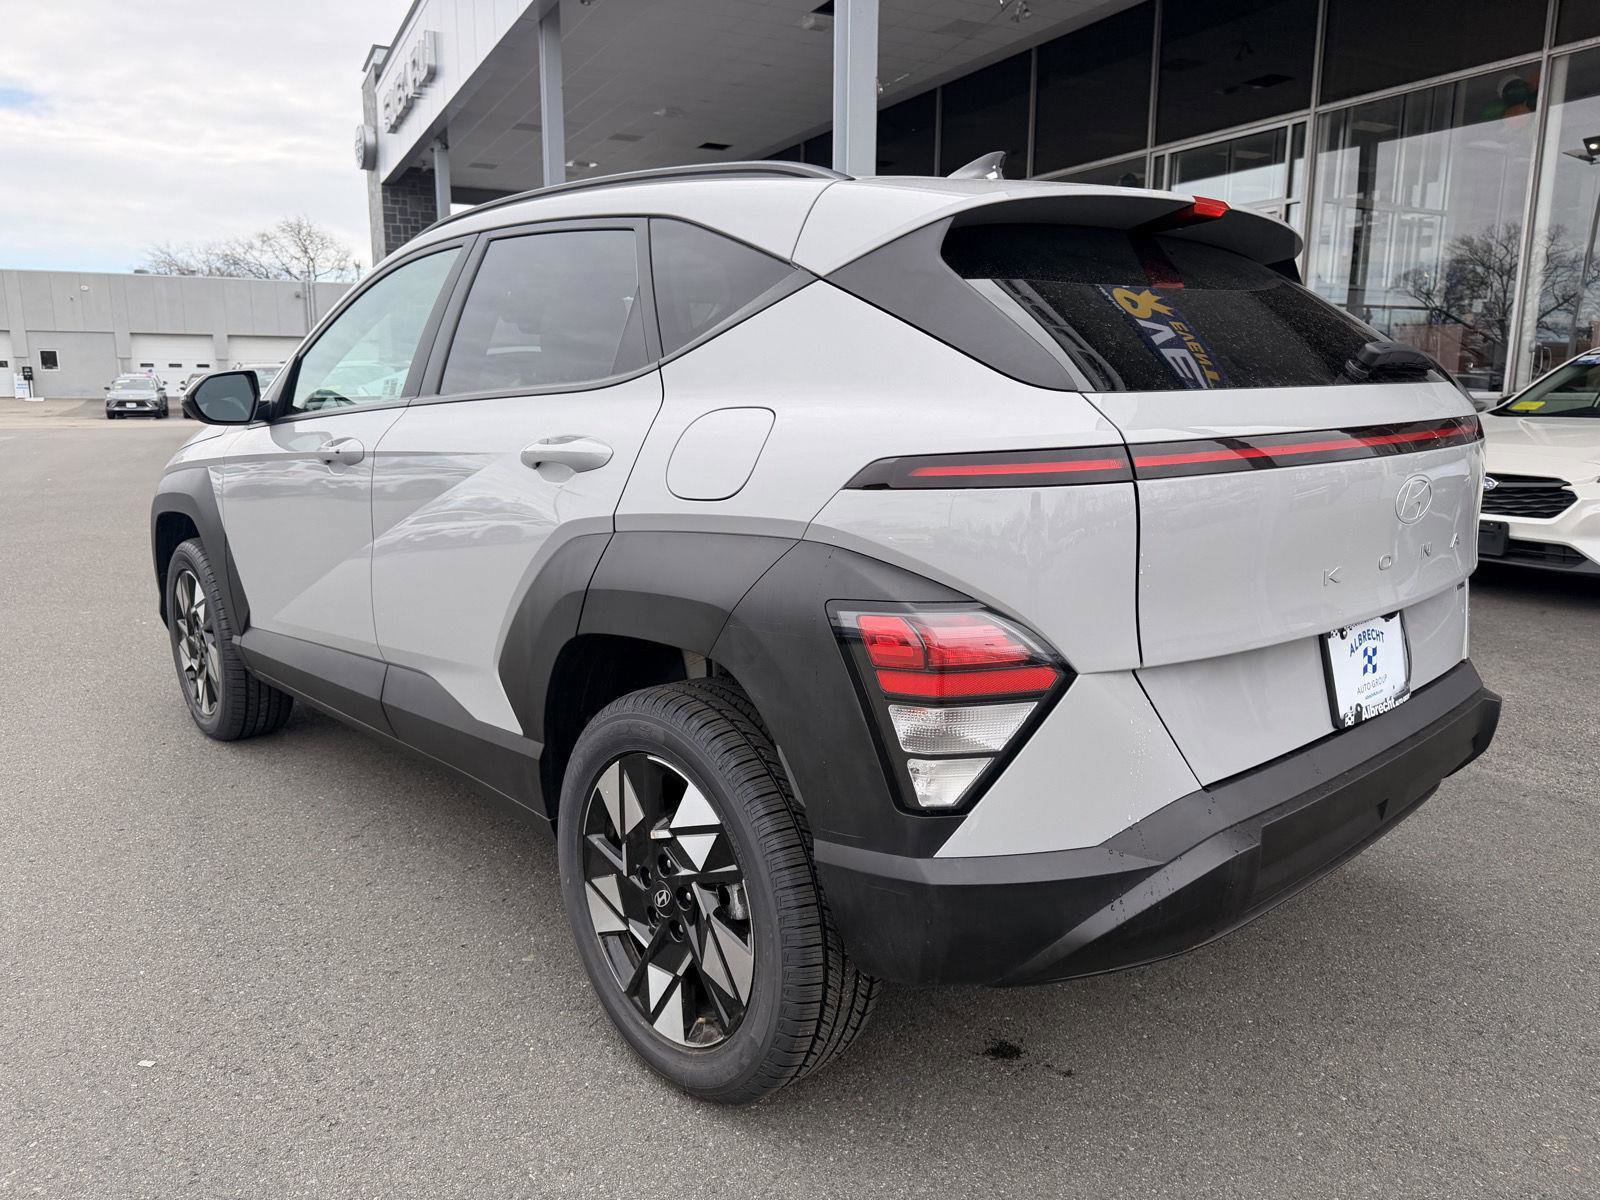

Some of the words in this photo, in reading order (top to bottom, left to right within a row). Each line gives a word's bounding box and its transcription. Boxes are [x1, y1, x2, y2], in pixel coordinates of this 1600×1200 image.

[1322, 532, 1460, 587] KONA
[1349, 628, 1385, 658] ALBRECHT
[1362, 695, 1396, 721] Albrecht
